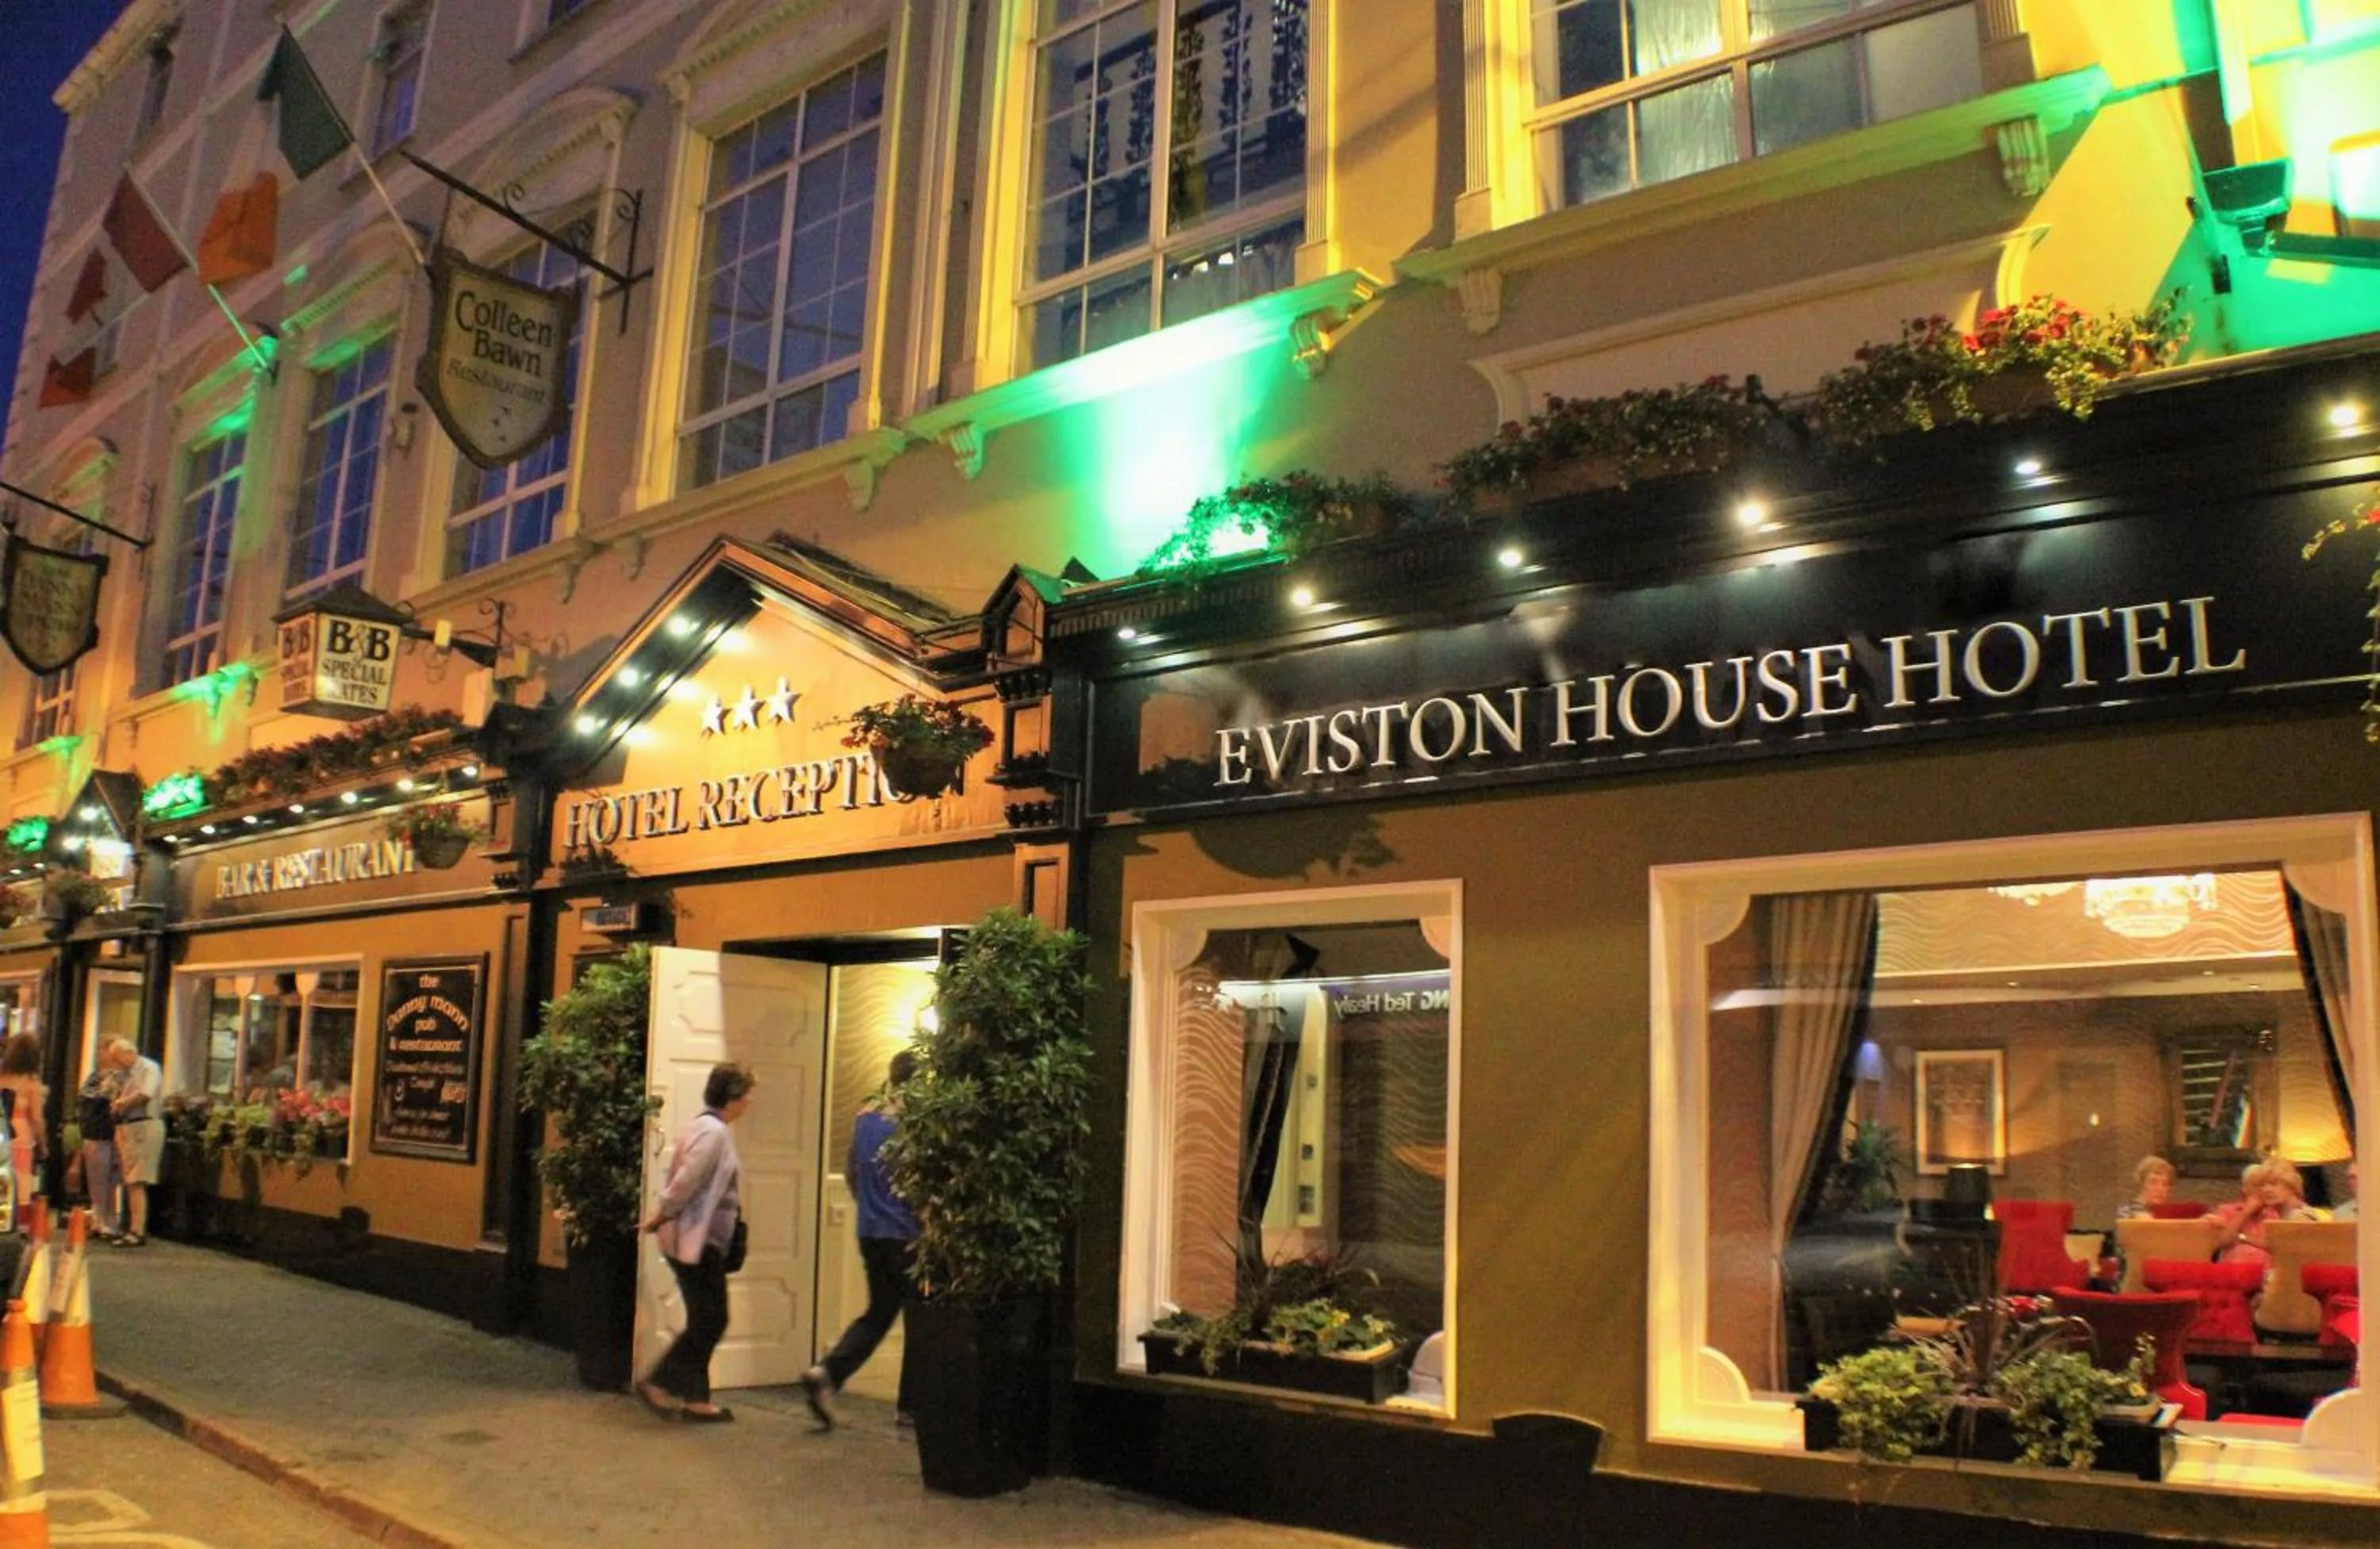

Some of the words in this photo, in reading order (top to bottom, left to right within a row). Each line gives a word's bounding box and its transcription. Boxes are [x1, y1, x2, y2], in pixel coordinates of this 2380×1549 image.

[455, 290, 552, 348] Colleen
[474, 329, 542, 377] Bawn
[322, 658, 386, 686] SPECIAL
[327, 680, 378, 705] ATES
[1212, 687, 1528, 786] EVISTON
[1549, 643, 1857, 747] HOUSE
[1881, 596, 2246, 708] HOTEL
[564, 786, 689, 848] HOTEL
